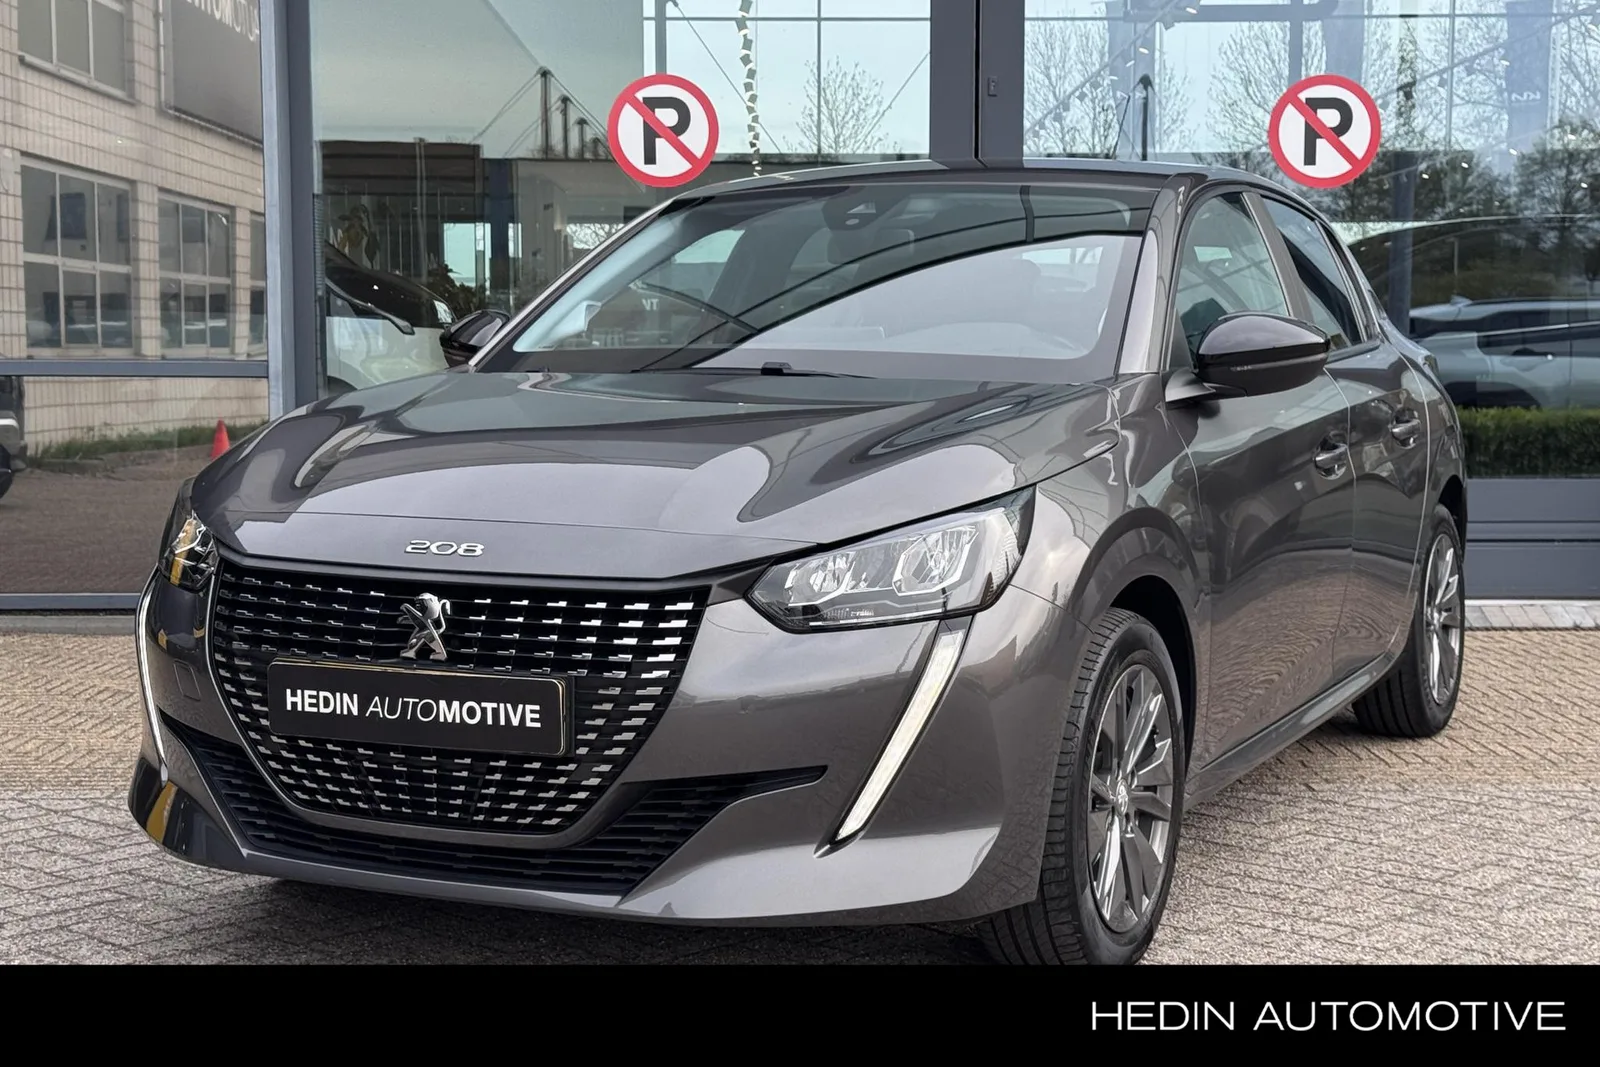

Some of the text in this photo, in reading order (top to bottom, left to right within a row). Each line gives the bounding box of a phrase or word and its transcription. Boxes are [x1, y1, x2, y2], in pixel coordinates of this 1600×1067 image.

[642, 96, 691, 165] P
[1303, 97, 1353, 166] P
[404, 539, 485, 557] 208
[286, 688, 542, 728] HEDIN AUTOMOTIVE
